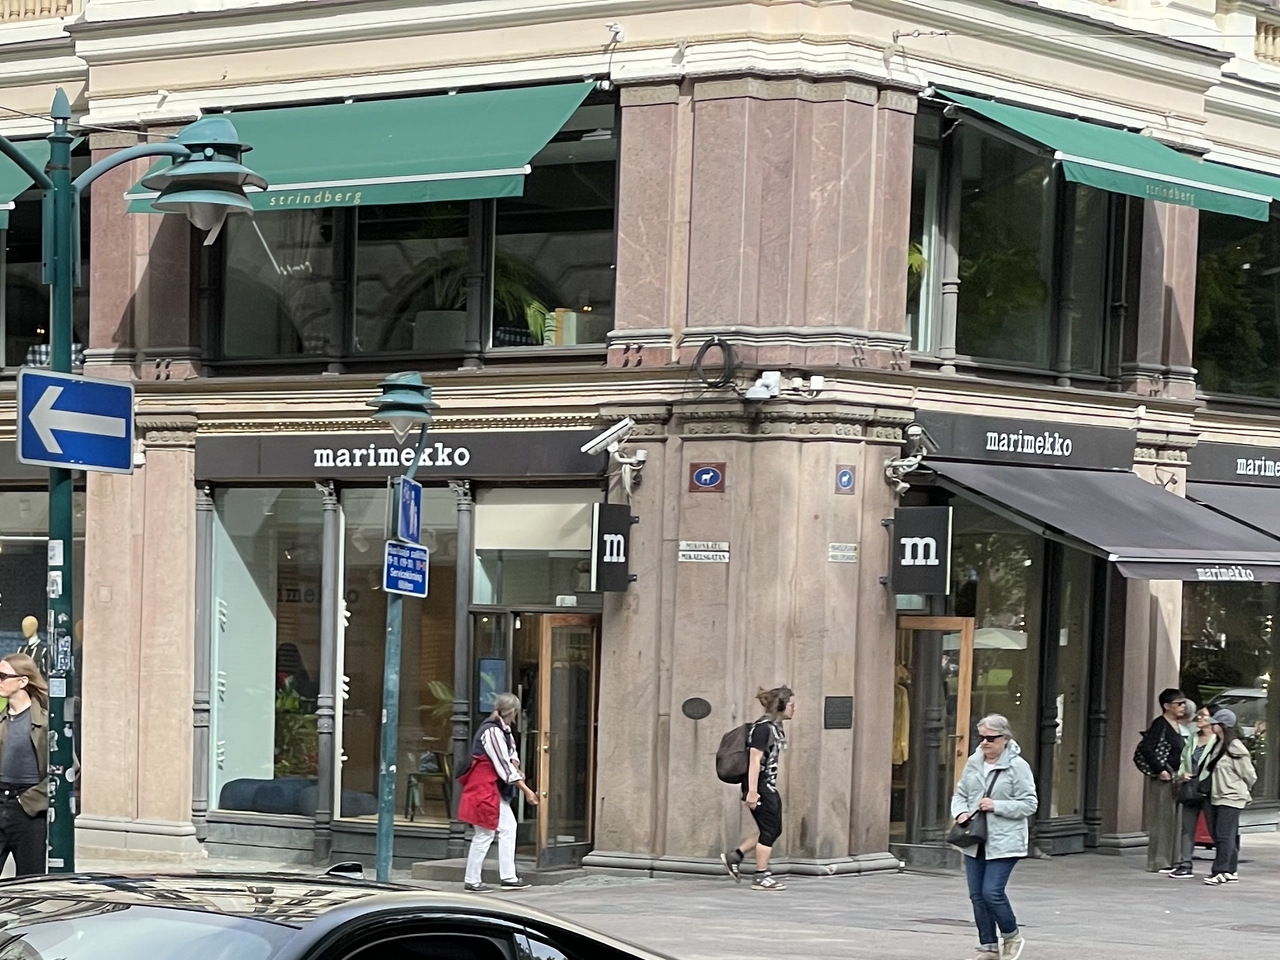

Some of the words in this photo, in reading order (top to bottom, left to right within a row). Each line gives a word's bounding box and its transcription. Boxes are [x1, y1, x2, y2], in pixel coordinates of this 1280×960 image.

[269, 190, 362, 206] strindberg
[1145, 184, 1195, 206] strindberg
[314, 442, 470, 467] marimekko
[985, 429, 1072, 456] marimekko
[603, 533, 626, 563] m
[900, 536, 940, 566] m
[1196, 564, 1255, 581] marimekko
